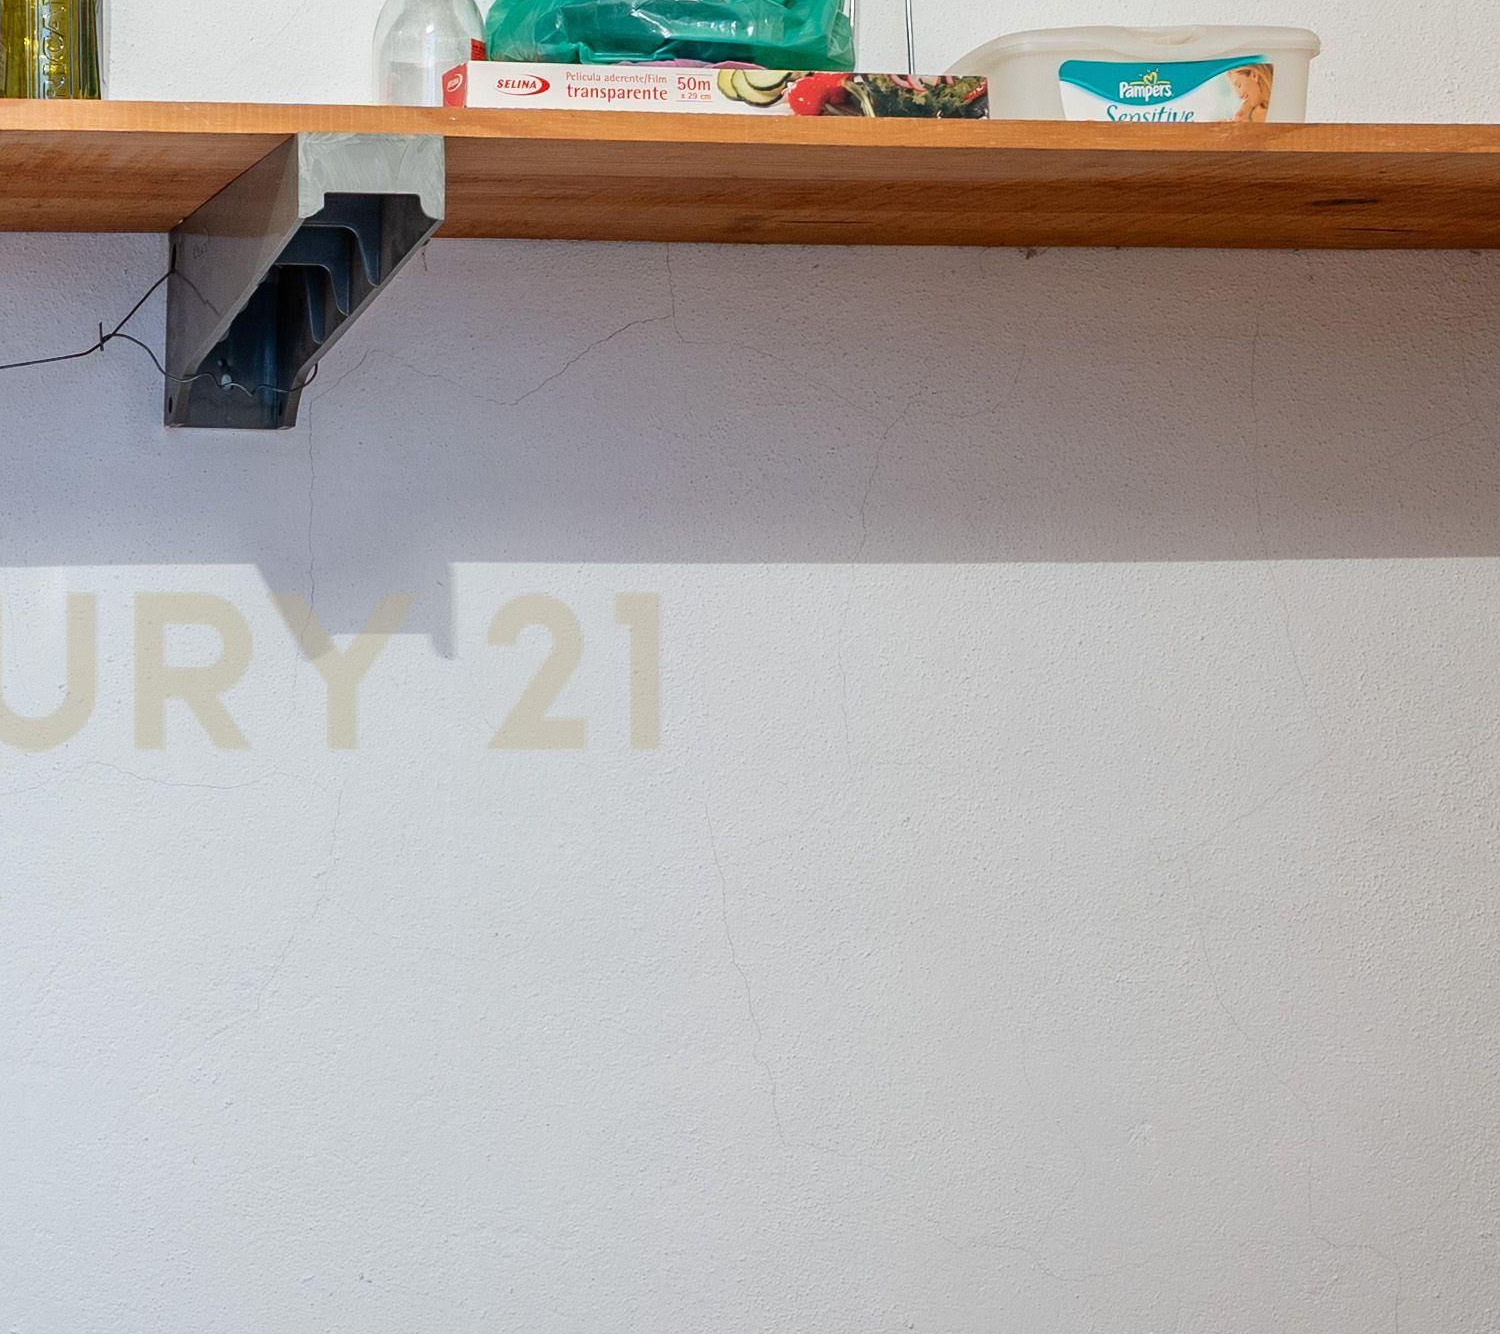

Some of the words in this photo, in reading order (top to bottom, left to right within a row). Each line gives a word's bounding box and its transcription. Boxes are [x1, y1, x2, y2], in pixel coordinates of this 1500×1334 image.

[496, 79, 538, 90] SELINA
[567, 83, 668, 102] transparente
[677, 76, 711, 92] 50m
[1119, 81, 1172, 102] Pampers
